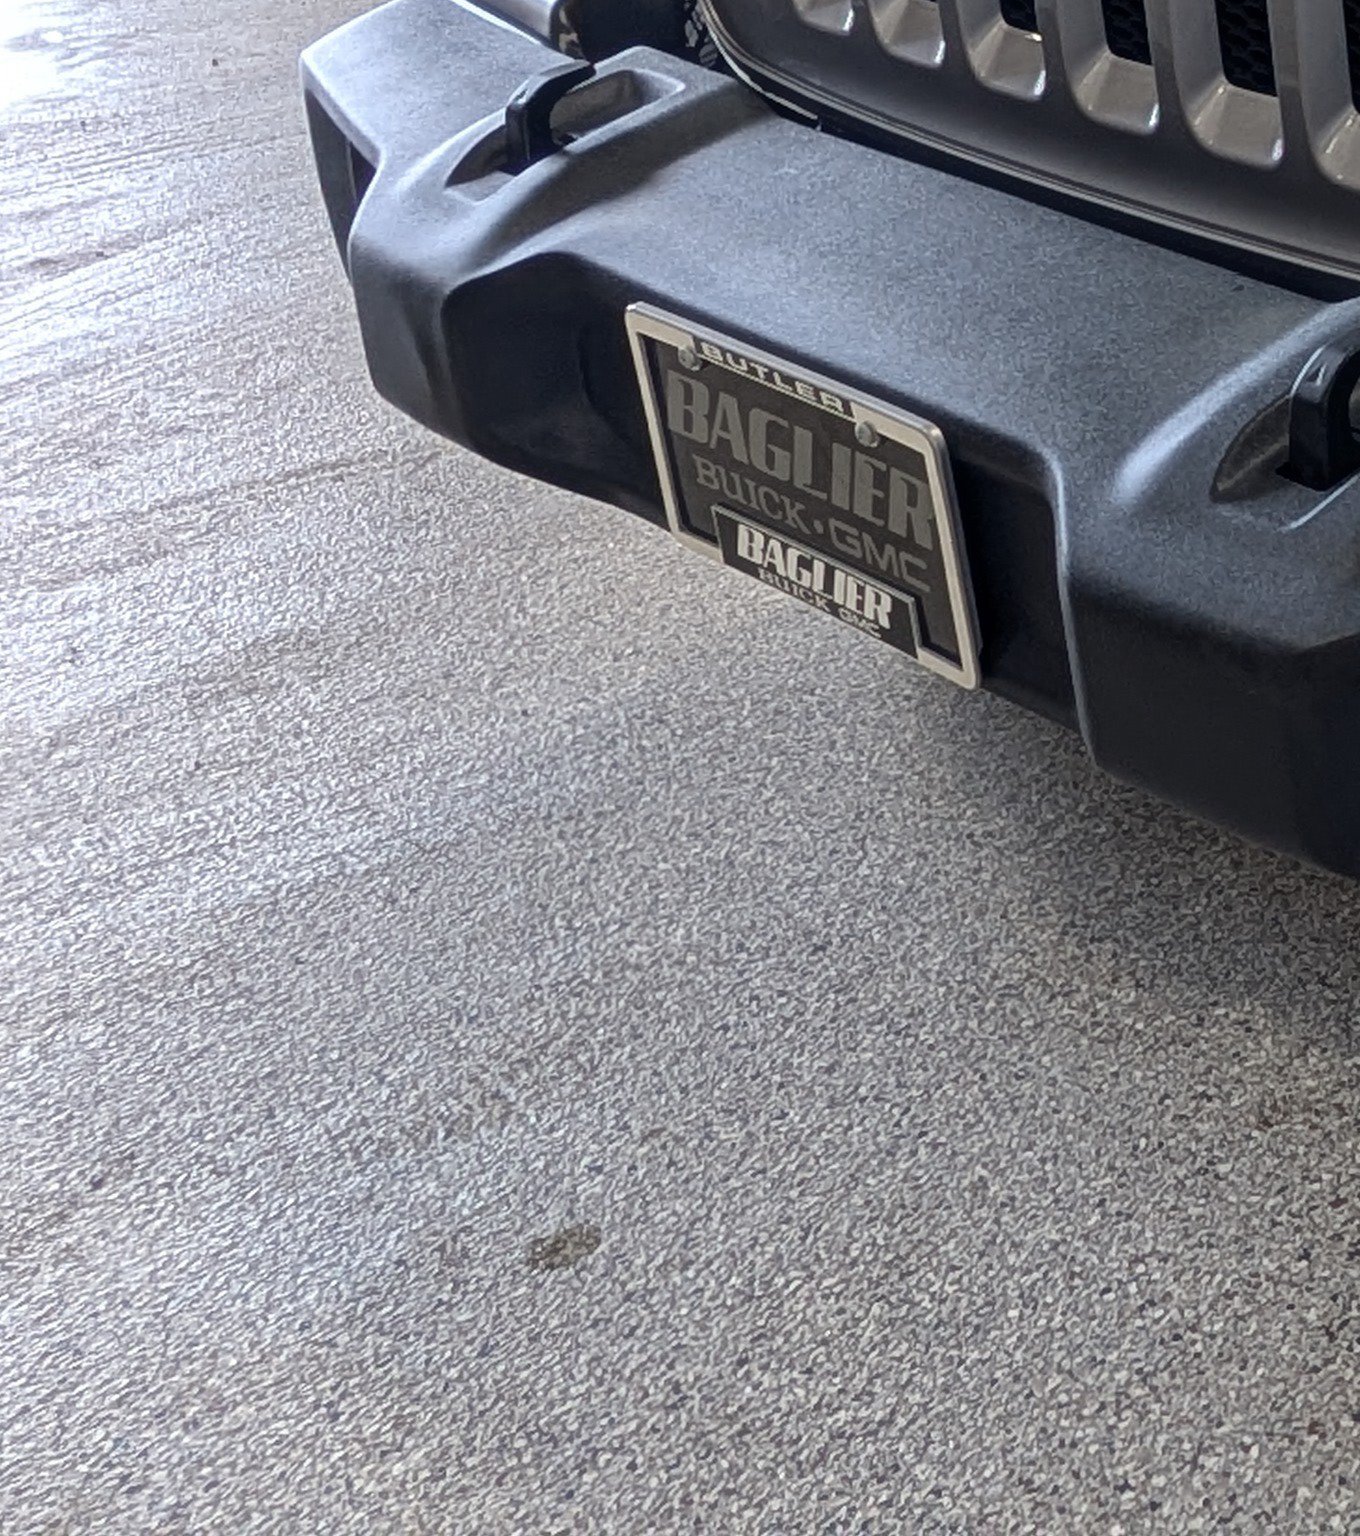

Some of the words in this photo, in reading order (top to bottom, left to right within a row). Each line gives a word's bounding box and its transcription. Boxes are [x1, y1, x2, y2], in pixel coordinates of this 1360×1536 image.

[701, 342, 844, 412] BUTLER
[667, 369, 933, 550] BAGLIER
[693, 454, 811, 534] BUICK
[828, 517, 930, 592] GMC
[737, 524, 892, 629] BAGLIER
[758, 567, 831, 612] BUICK
[838, 607, 881, 638] GMC
